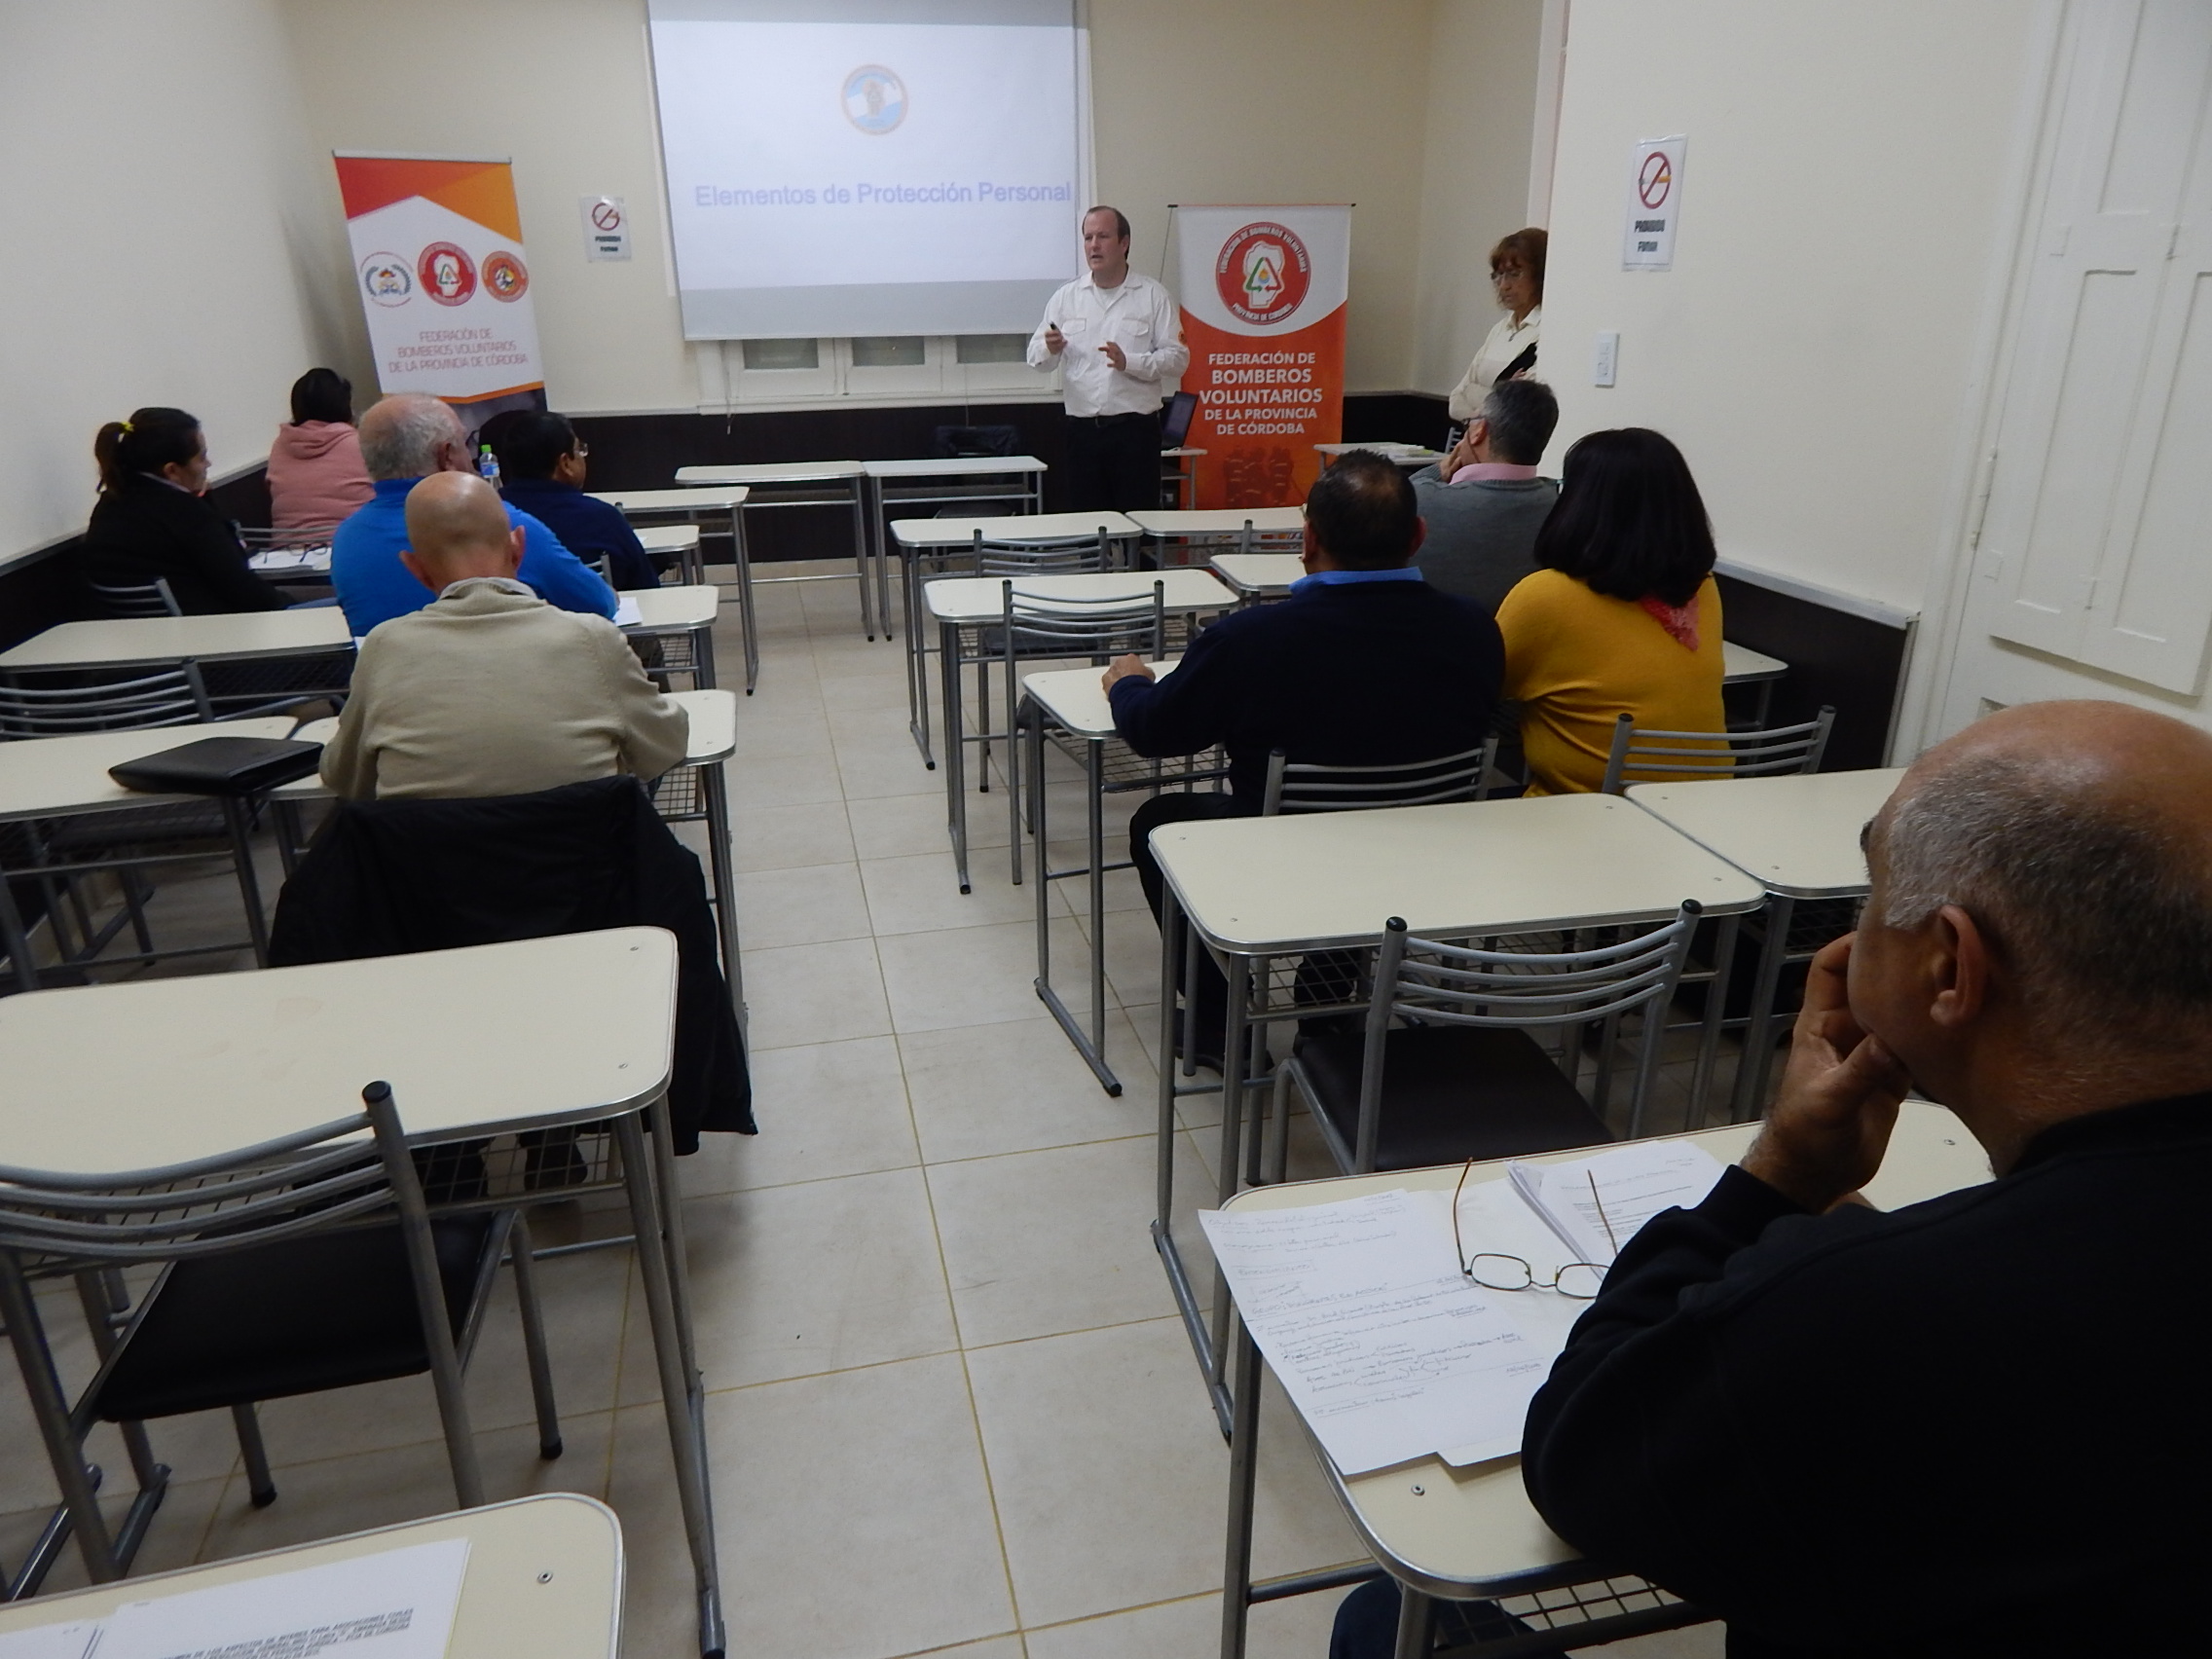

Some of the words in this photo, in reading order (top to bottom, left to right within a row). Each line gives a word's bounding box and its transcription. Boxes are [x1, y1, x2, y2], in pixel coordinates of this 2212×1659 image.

[695, 184, 817, 206] Elementos
[823, 183, 851, 204] de
[857, 181, 973, 203] Protección
[978, 181, 1071, 202] Personal
[479, 328, 492, 339] DE
[397, 345, 454, 358] BOMBEROS
[455, 341, 517, 354] VOLUNTARIOS
[1208, 350, 1295, 365] FEDERACIÓN
[1297, 352, 1316, 364] DE
[388, 361, 402, 373] DE
[404, 360, 418, 372] LA
[420, 357, 468, 370] PROVINCIA
[470, 355, 484, 367] DE
[1211, 368, 1312, 385] BOMBEROS
[1198, 388, 1323, 405] VOLUNTARIOS
[1204, 409, 1222, 421] DE
[1225, 408, 1242, 421] LA
[1244, 407, 1317, 420] PROVINCIA
[1217, 424, 1235, 435] DE
[1237, 421, 1306, 435] CÓRDOBA
